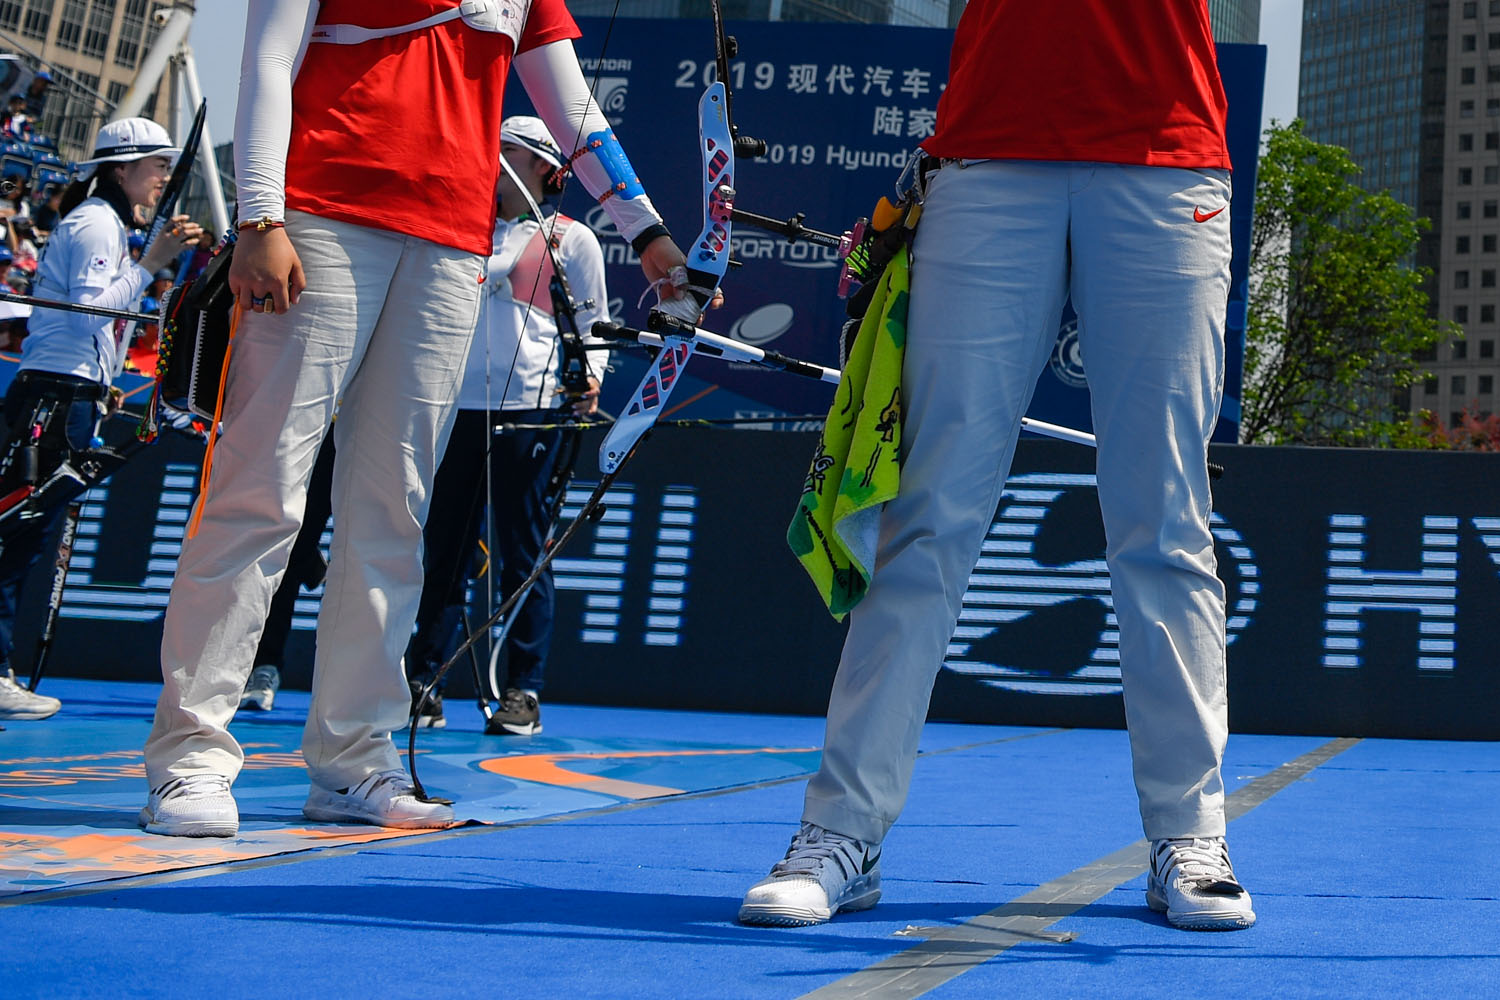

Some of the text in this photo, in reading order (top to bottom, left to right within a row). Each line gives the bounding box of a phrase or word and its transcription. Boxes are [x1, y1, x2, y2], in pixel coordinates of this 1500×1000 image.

[579, 58, 632, 72] YUNDAI
[675, 59, 776, 90] 2019
[826, 145, 914, 171] Hyund
[813, 233, 840, 246] SHIBUYA
